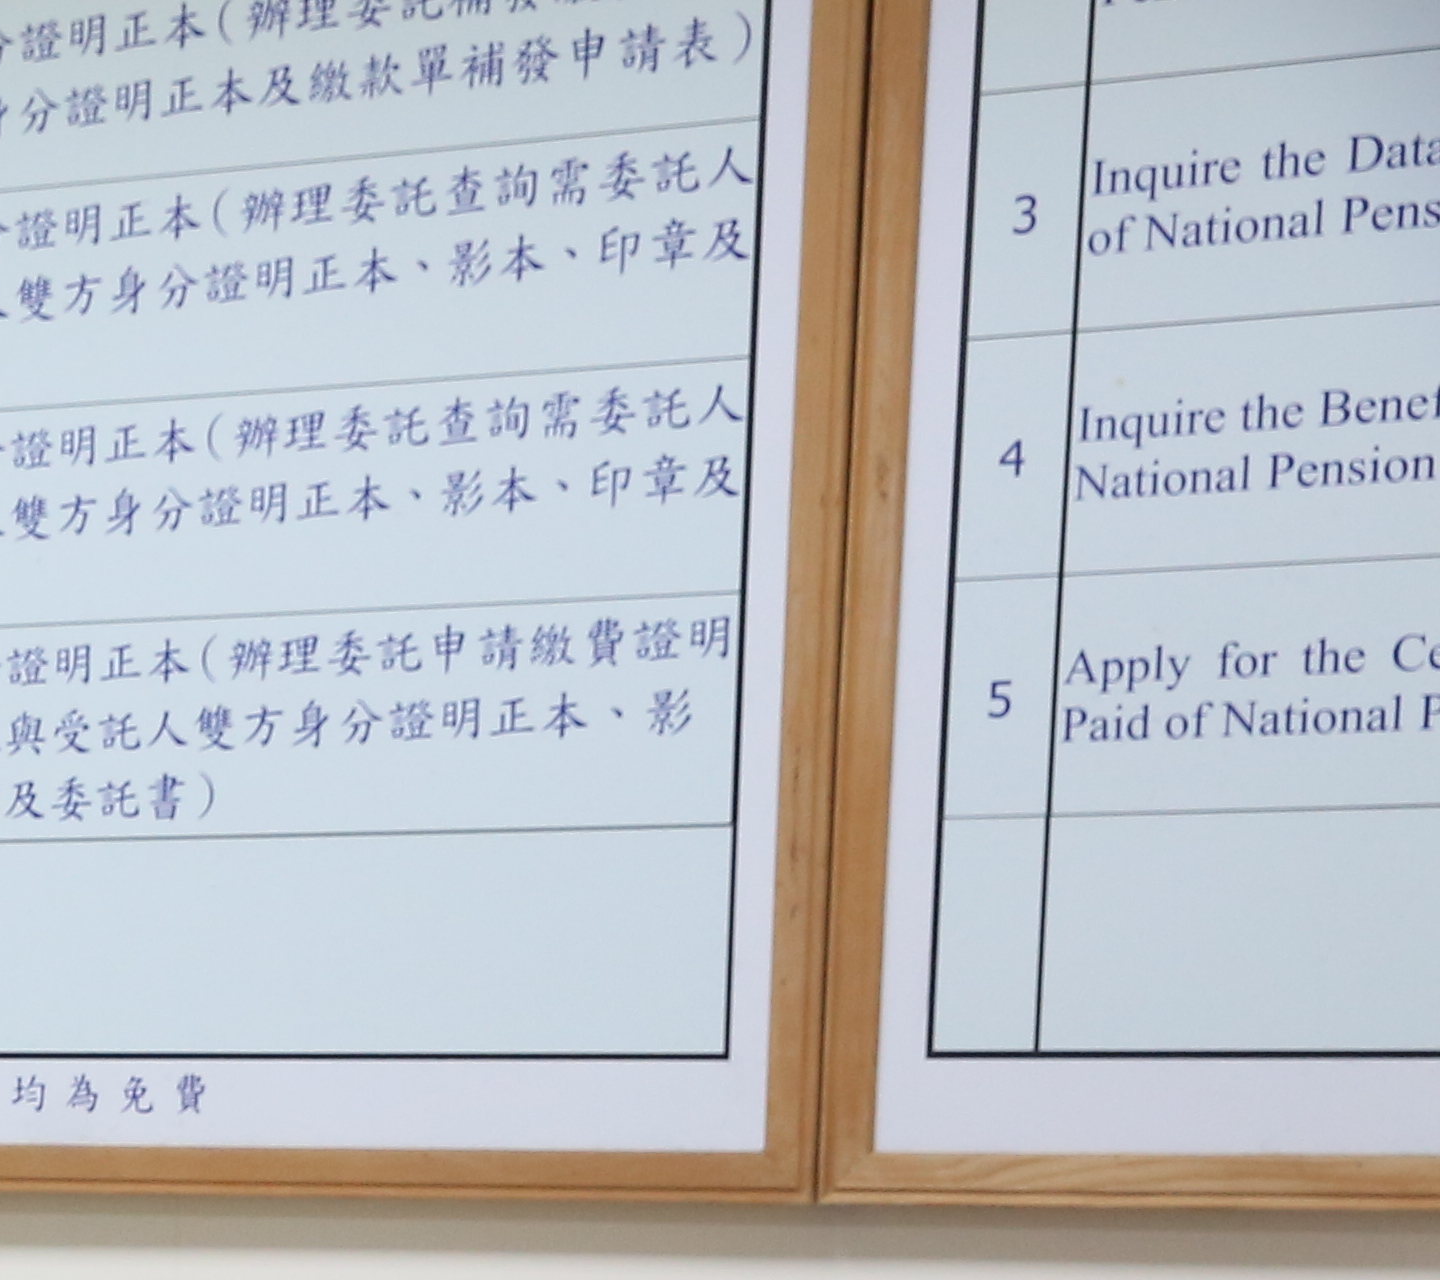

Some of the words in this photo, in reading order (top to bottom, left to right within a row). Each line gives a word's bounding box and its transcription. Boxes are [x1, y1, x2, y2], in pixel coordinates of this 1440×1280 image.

[1092, 148, 1242, 202] Inquire
[1262, 138, 1326, 180] the
[1012, 195, 1039, 235] 3
[1087, 215, 1131, 256] of
[1144, 200, 1324, 251] National
[1079, 397, 1226, 450] Inquire
[1241, 390, 1304, 431] the
[999, 439, 1025, 479] 4
[1074, 455, 1250, 502] National
[1268, 447, 1435, 492] Pension
[1065, 645, 1191, 693] Apply
[1220, 640, 1278, 679] for
[1302, 637, 1366, 676] the
[987, 680, 1013, 719] 5
[1062, 703, 1151, 743] Paid
[1165, 701, 1212, 740] of
[1221, 694, 1403, 737] National
